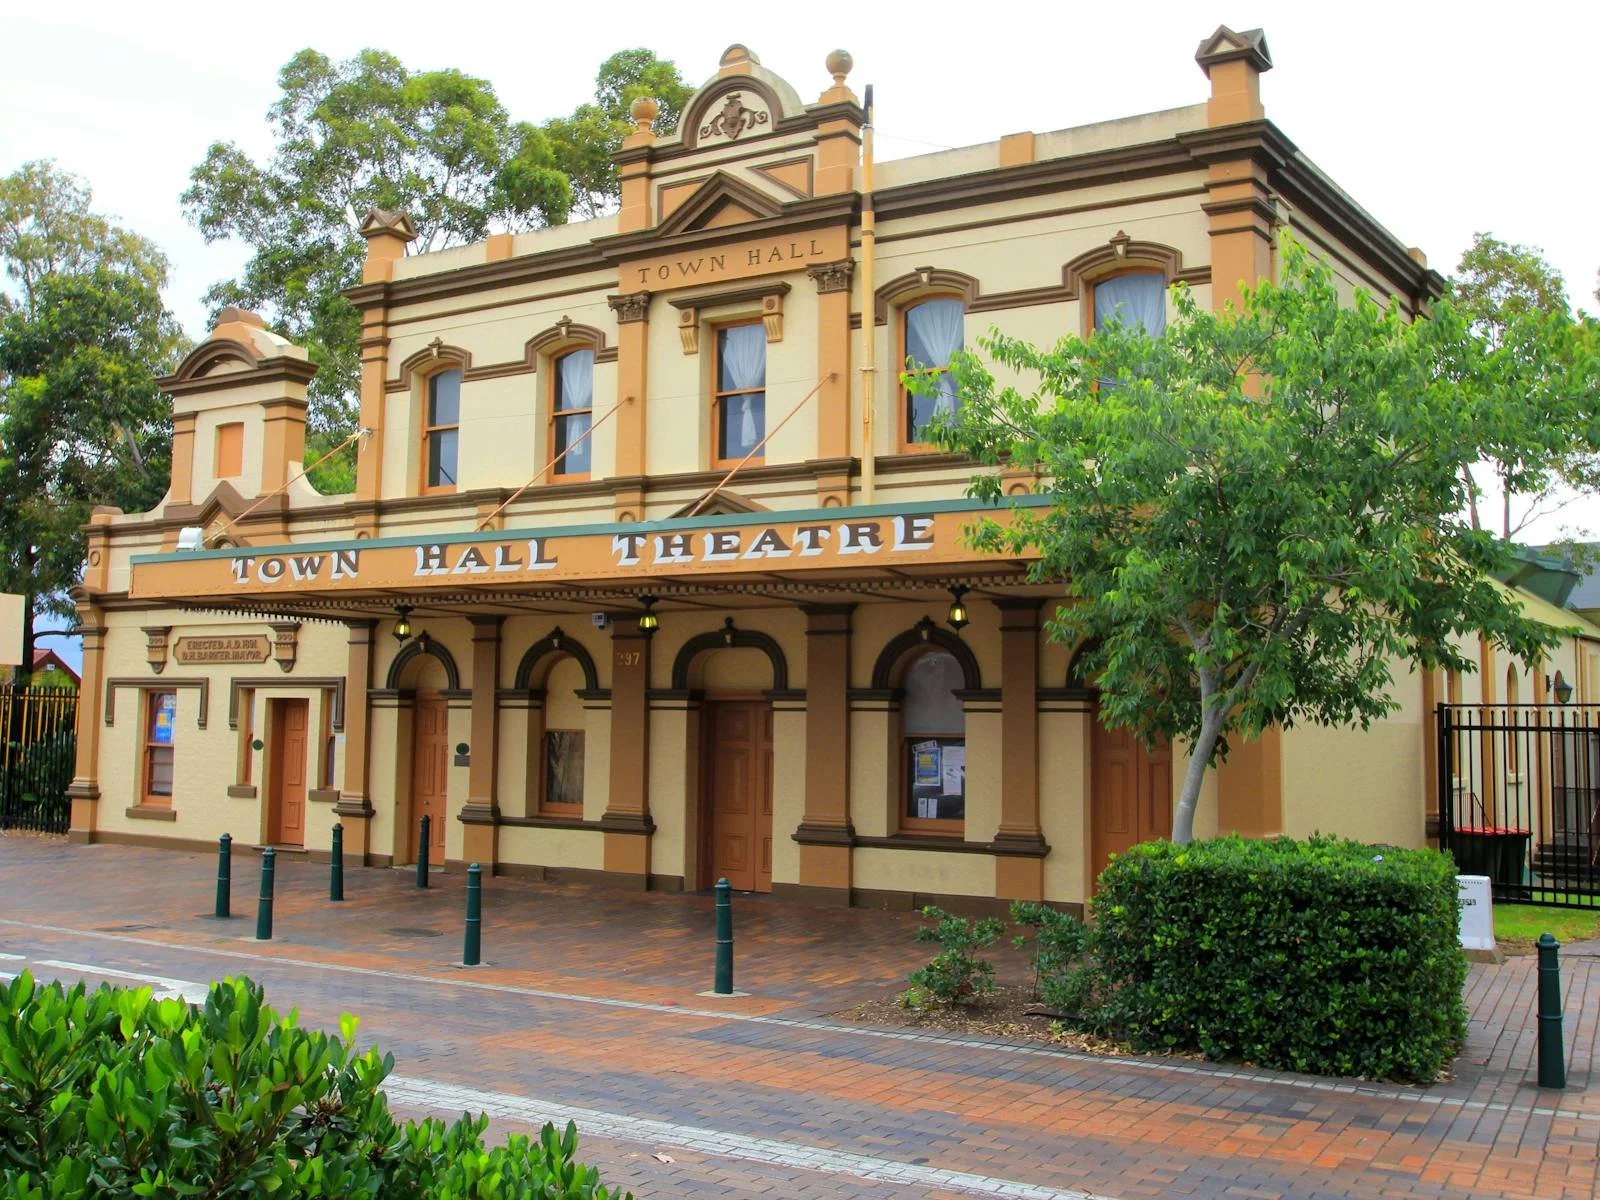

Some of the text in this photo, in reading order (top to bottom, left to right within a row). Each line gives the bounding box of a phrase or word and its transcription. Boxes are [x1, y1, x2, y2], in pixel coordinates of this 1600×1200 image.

[638, 240, 824, 284] TOWN HALL
[231, 513, 935, 584] TOWN HALL THEATRE
